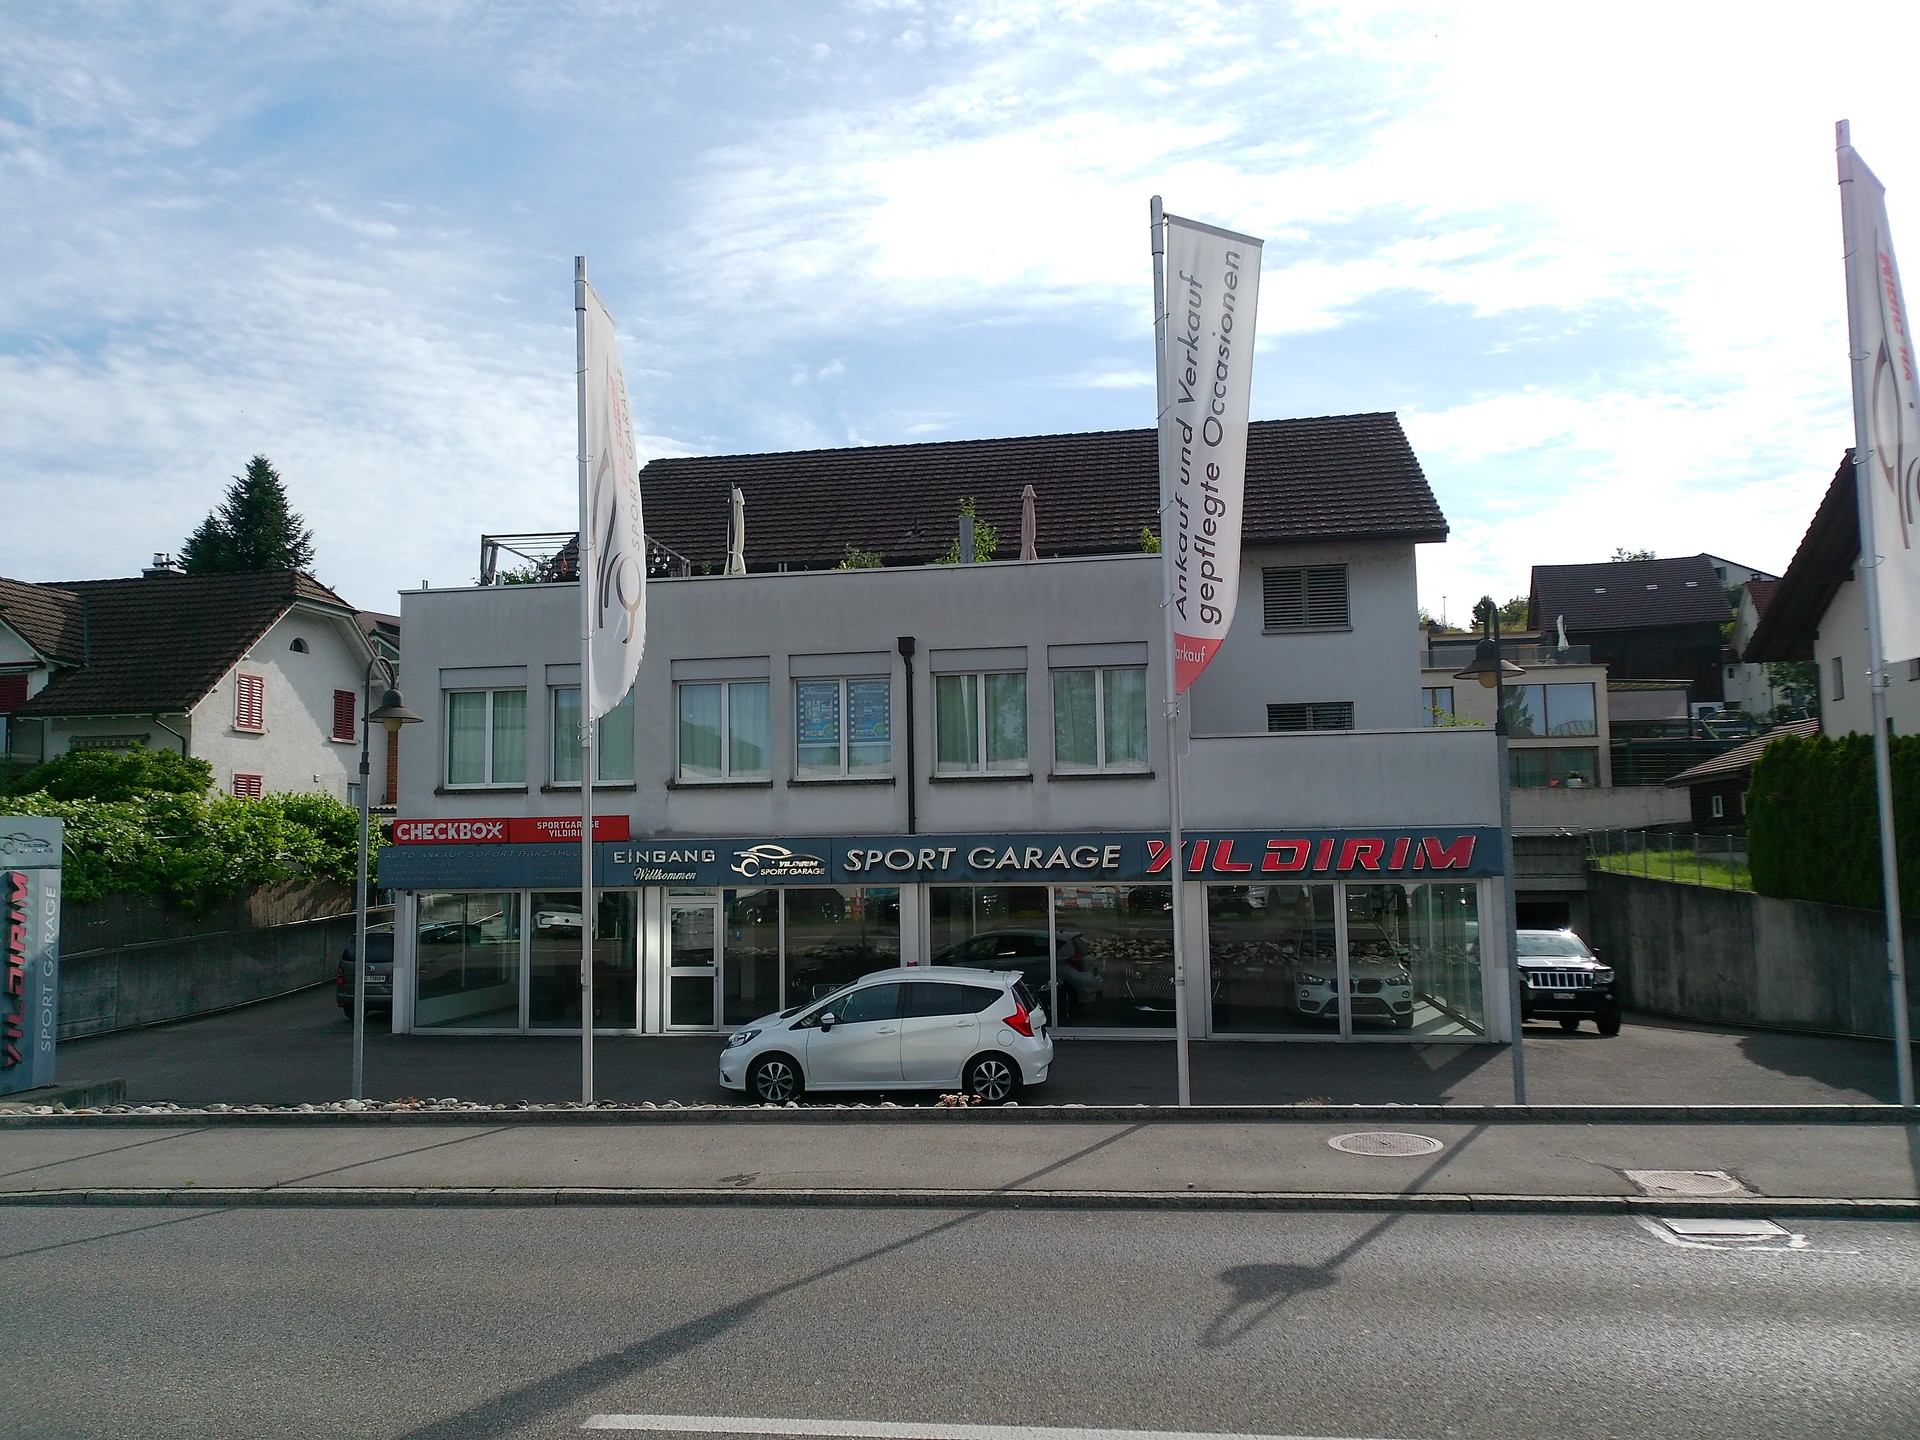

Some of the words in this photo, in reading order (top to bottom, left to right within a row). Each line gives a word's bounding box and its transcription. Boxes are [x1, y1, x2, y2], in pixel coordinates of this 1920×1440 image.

[1177, 270, 1204, 404] Verkauf
[1201, 250, 1241, 448] Occasionen
[1176, 417, 1194, 486] und
[629, 475, 640, 551] SPORT
[1194, 461, 1225, 626] gepflegte
[1174, 491, 1190, 622] Ankauf
[518, 849, 596, 857] BARZAHLUG
[537, 821, 600, 830] SPORTGARGE
[549, 829, 583, 838] YILDIRI
[613, 849, 716, 864] EINGANG
[843, 847, 957, 871] SPORT
[966, 845, 1122, 870] GARAGE
[1146, 836, 1476, 873] YILDIRIM
[633, 867, 697, 880] Willkommen
[760, 868, 787, 876] SPORT
[789, 867, 826, 876] GARAGE
[43, 886, 57, 977] GARAGE
[7, 871, 29, 1066] YILDIRIM
[41, 984, 54, 1053] SPORT
